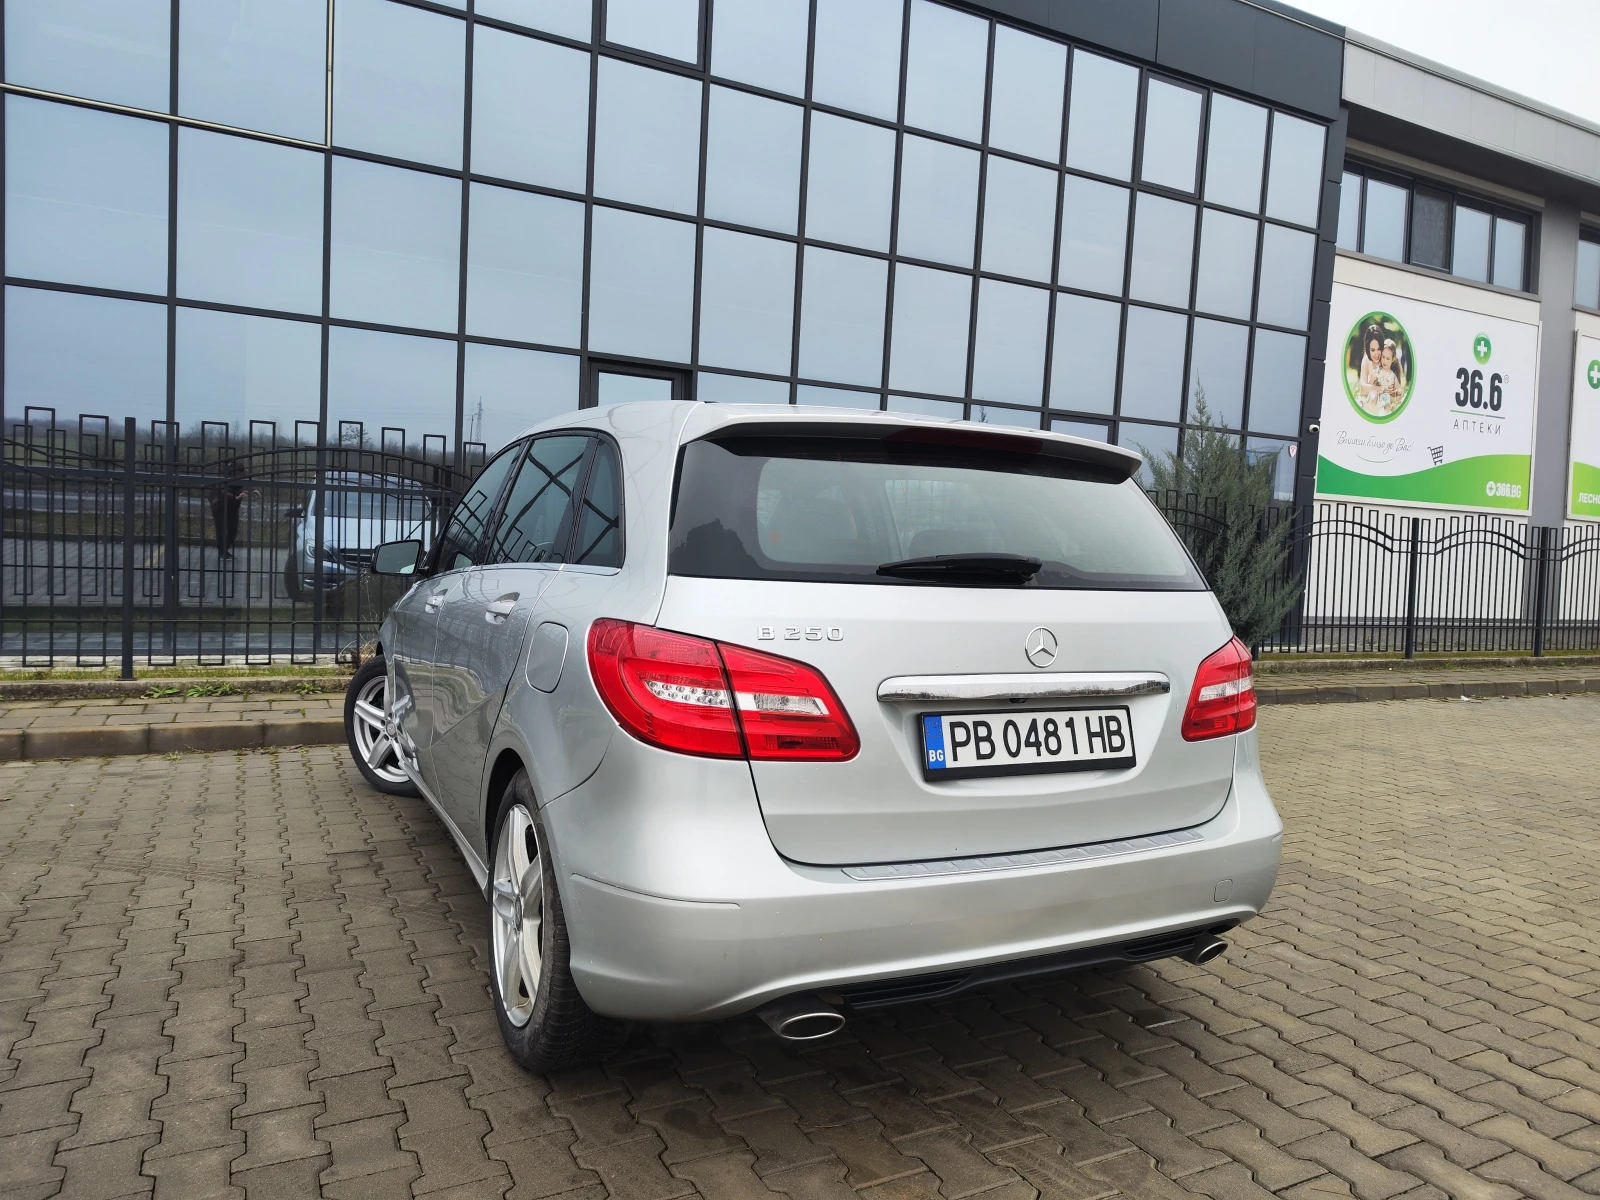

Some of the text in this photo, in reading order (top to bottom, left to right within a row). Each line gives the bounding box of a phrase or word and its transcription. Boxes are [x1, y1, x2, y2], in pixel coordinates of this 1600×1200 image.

[1455, 367, 1503, 412] 36.6
[1453, 418, 1501, 435] АПТЕКИ
[1496, 482, 1522, 498] 366.BG
[757, 626, 845, 642] B 250
[1002, 716, 1078, 758] 0481
[928, 749, 944, 762] BG
